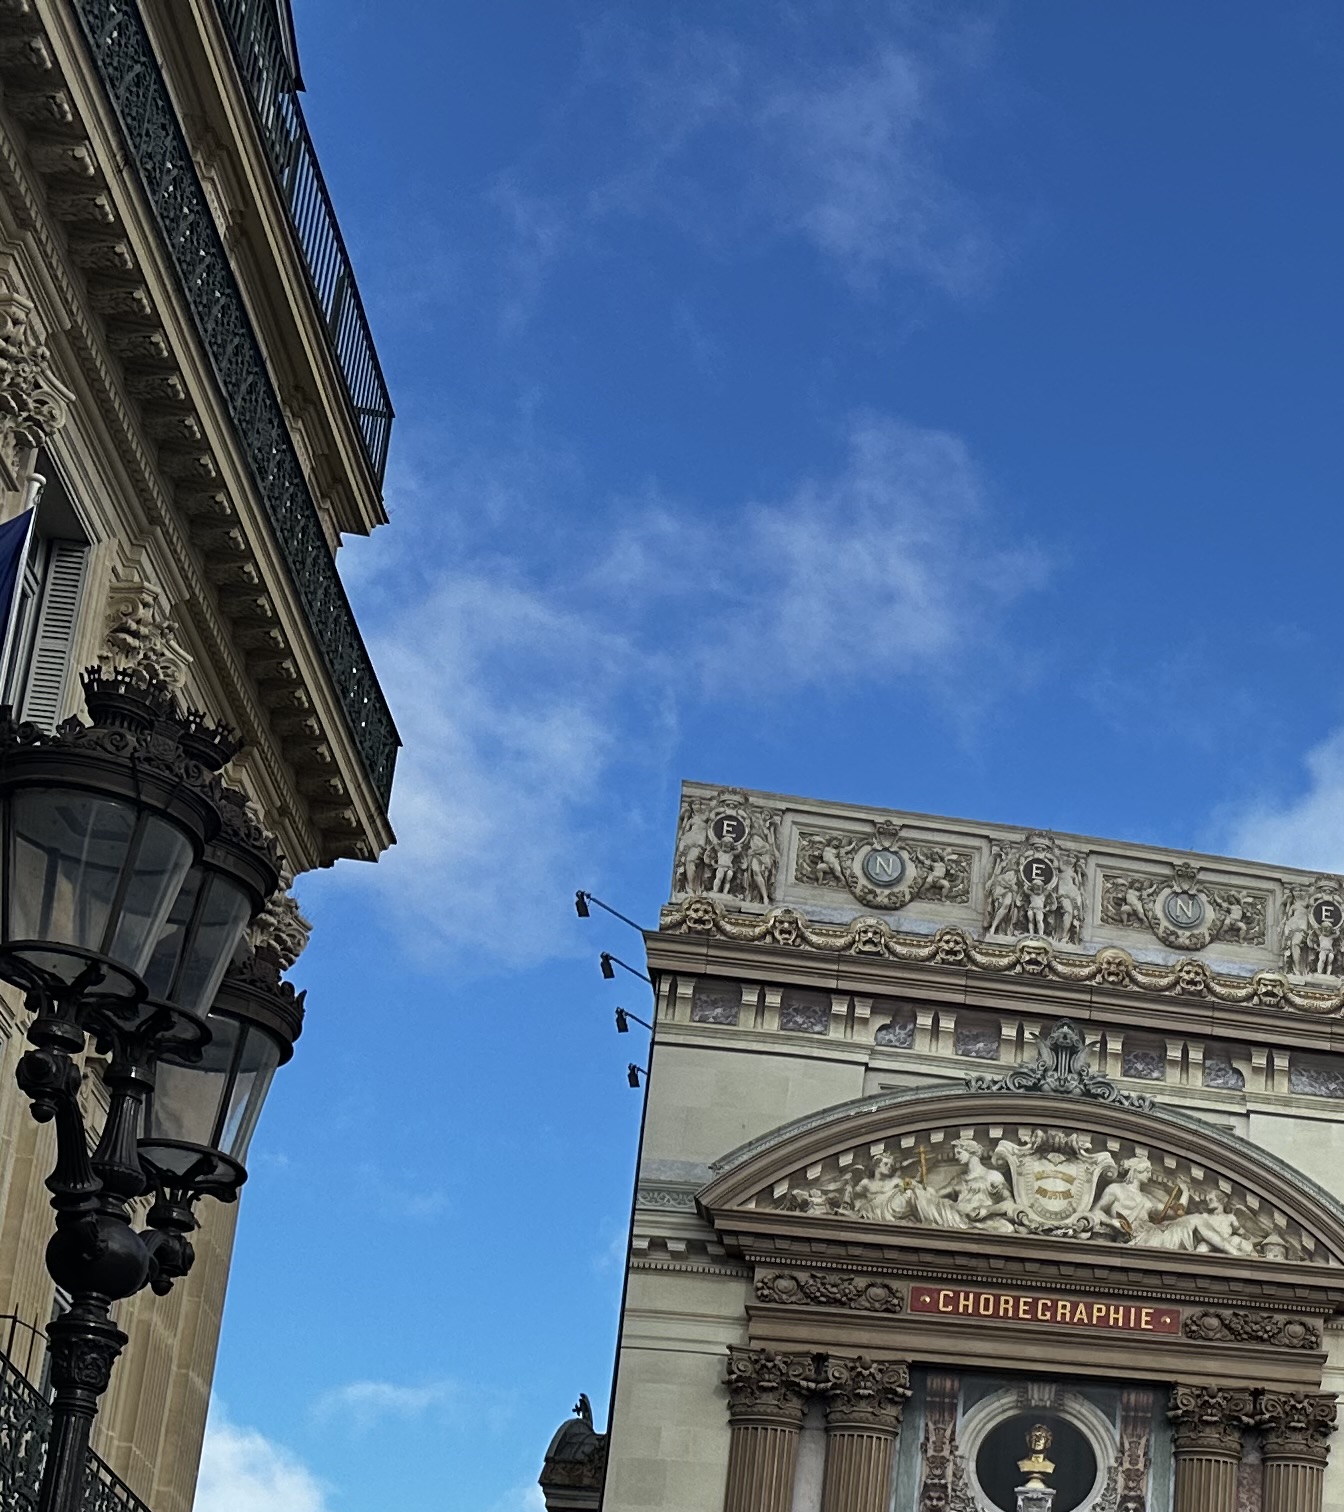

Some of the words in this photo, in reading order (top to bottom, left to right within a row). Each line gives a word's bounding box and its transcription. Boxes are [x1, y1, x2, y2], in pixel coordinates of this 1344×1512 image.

[722, 821, 736, 837] E
[874, 856, 894, 877] N
[1032, 863, 1046, 881] E
[1175, 900, 1193, 919] N
[1320, 906, 1335, 922] E
[938, 1290, 1155, 1329] CHOREGRAPHIE
